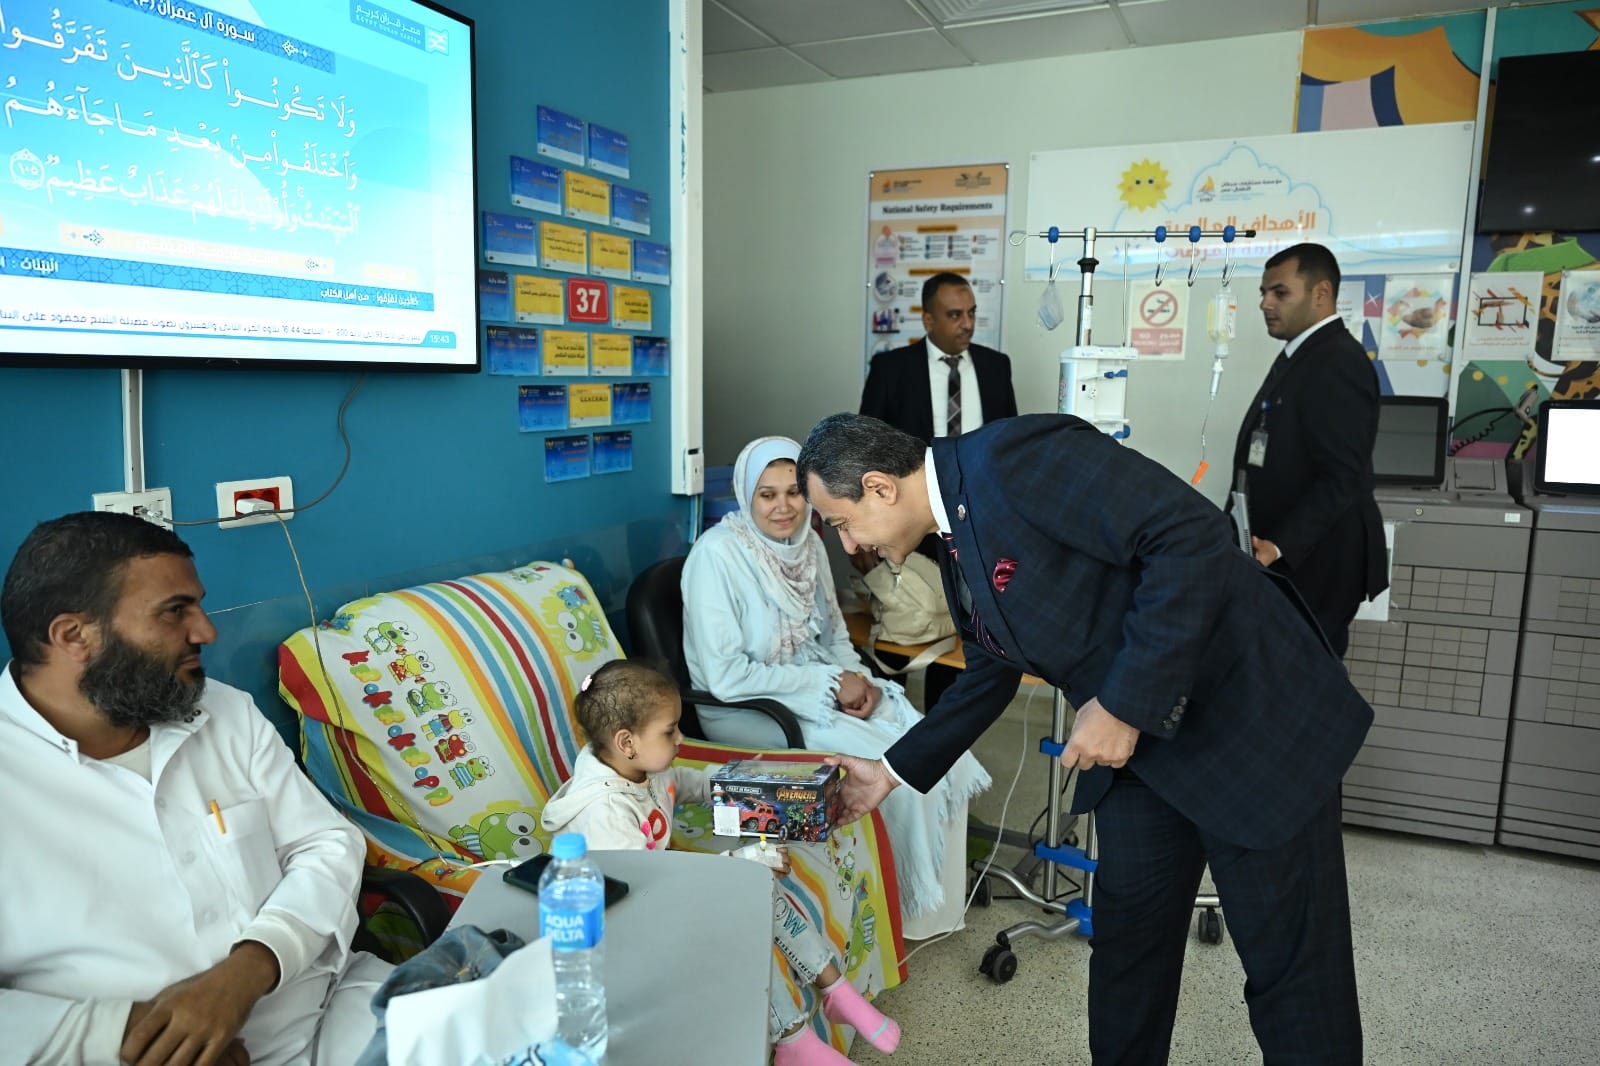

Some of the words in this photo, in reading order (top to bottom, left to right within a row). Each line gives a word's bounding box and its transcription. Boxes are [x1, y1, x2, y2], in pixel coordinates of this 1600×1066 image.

[157, 0, 197, 24] عمران
[200, 11, 213, 29] آل
[216, 18, 255, 42] سورة
[882, 205, 914, 215] National
[915, 204, 938, 215] Safety
[940, 202, 993, 214] Requirements
[1241, 209, 1316, 232] الأهداف
[576, 287, 601, 313] 37
[777, 788, 817, 801] AVENGERS
[545, 914, 585, 929] AQUA
[545, 926, 585, 942] DELTA
